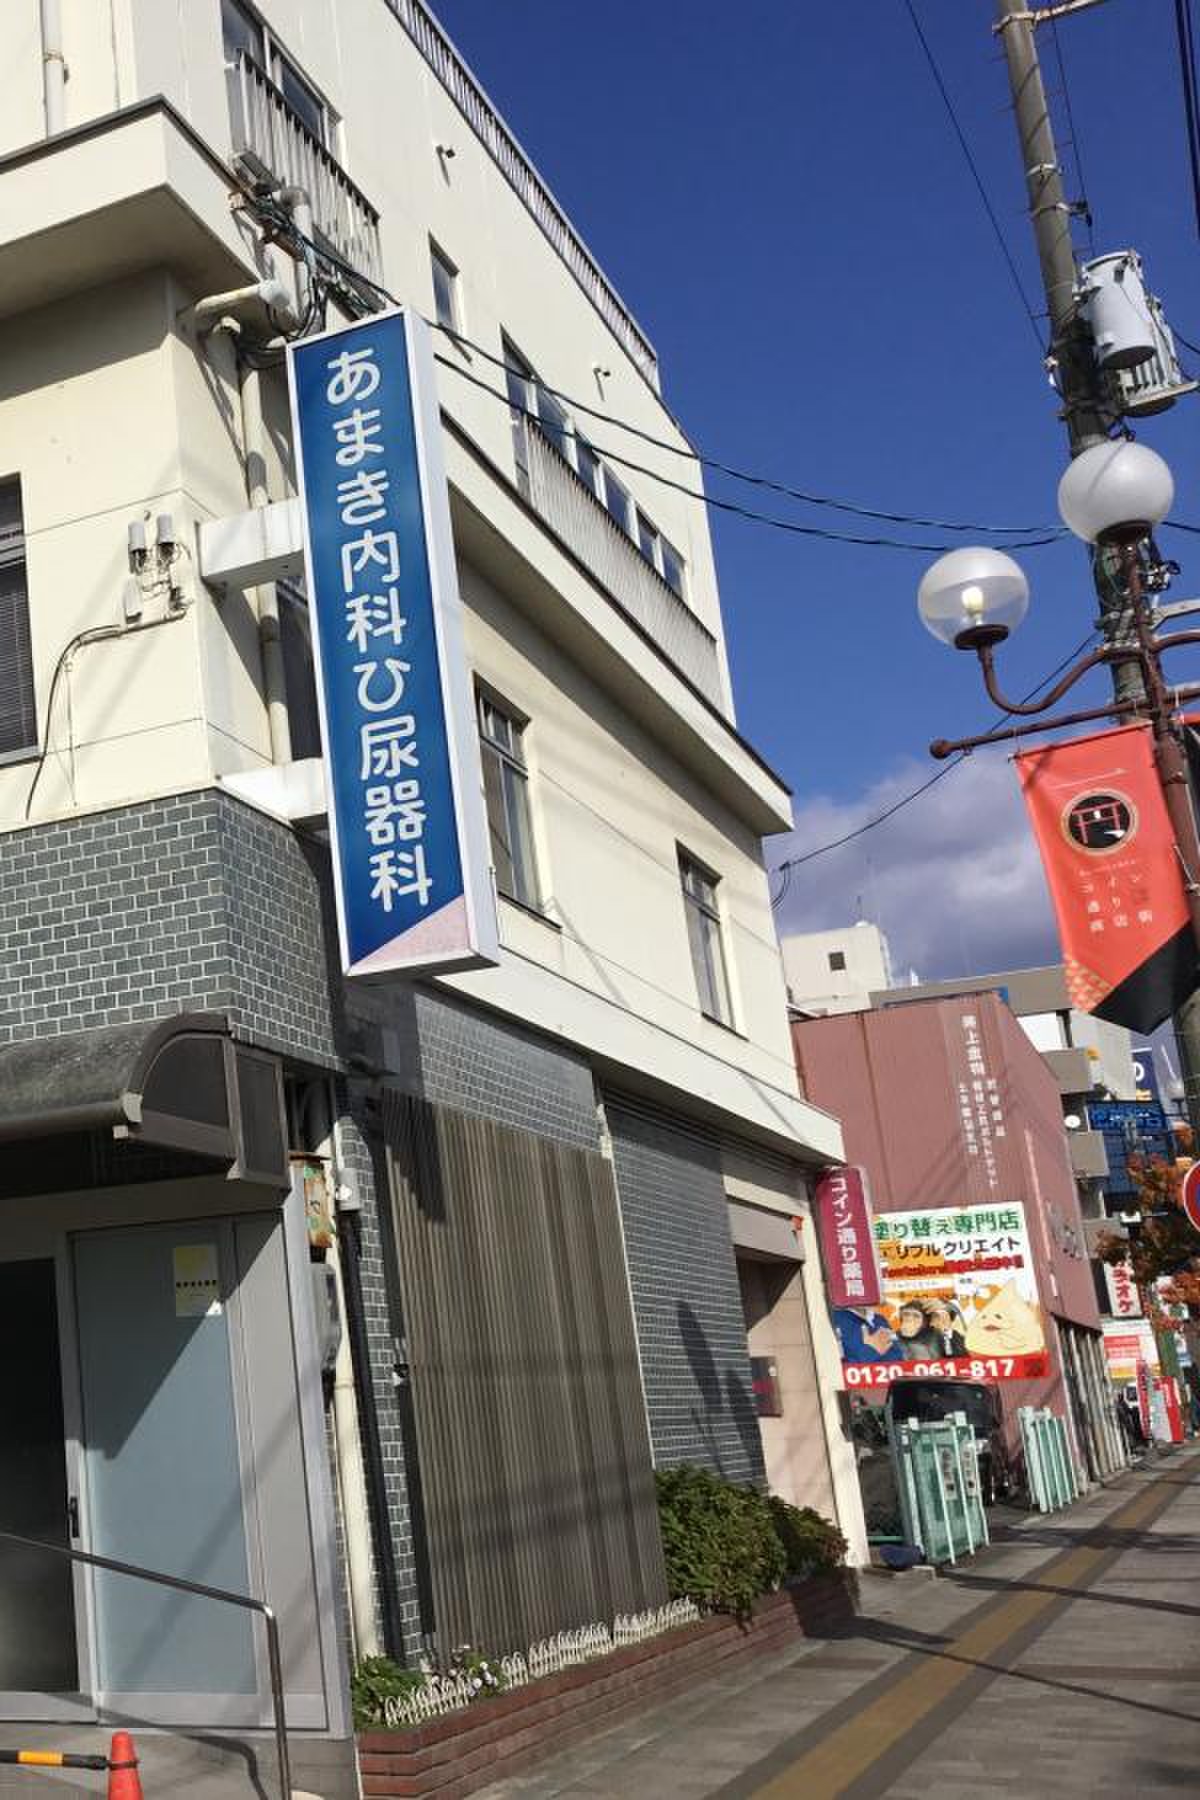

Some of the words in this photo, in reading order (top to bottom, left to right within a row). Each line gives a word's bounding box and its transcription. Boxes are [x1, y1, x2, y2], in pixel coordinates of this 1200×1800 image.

[327, 348, 433, 913] あまき内科ひ尿器科
[845, 1359, 1015, 1384] 0120-061-817
